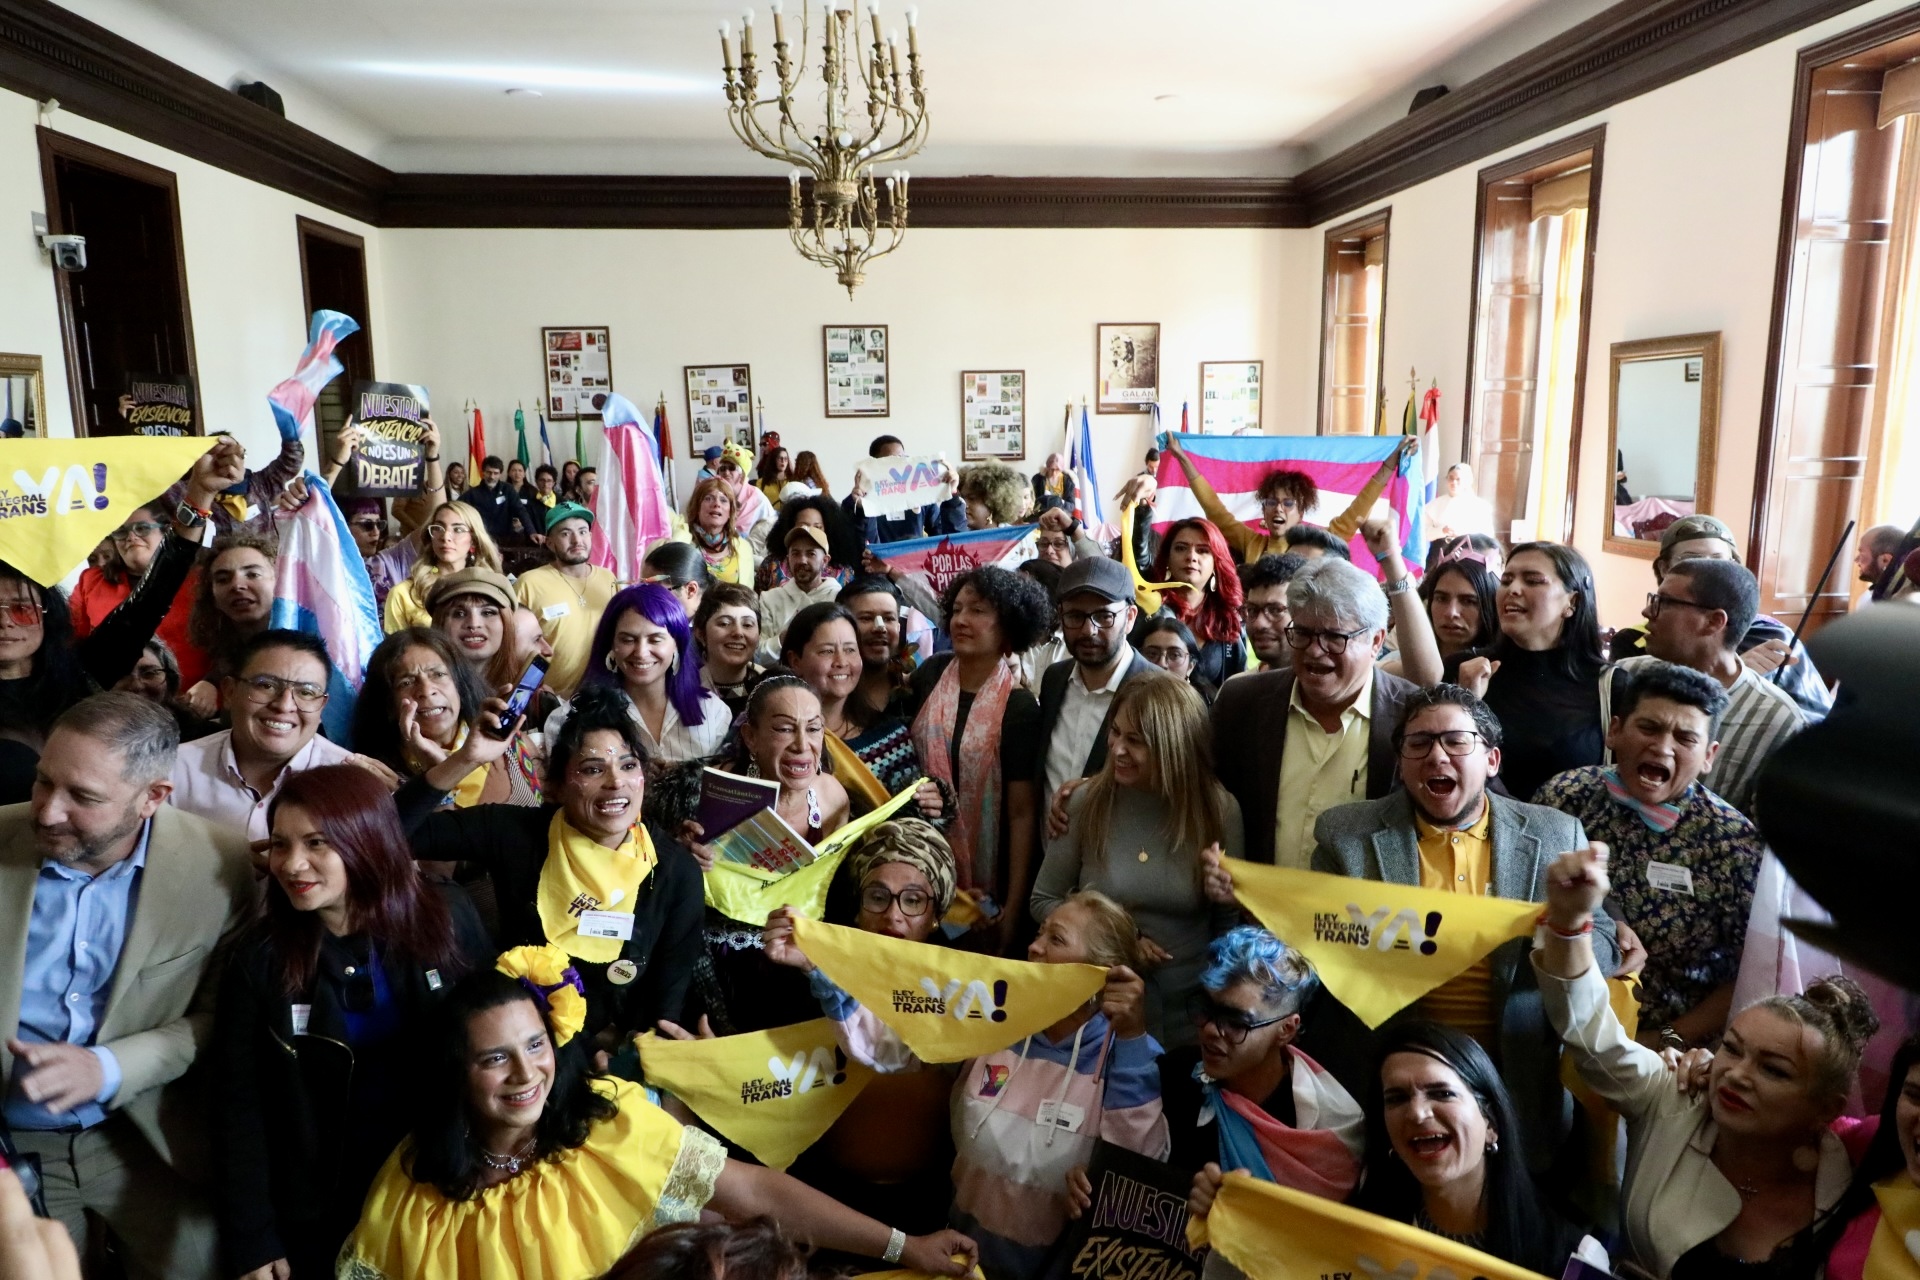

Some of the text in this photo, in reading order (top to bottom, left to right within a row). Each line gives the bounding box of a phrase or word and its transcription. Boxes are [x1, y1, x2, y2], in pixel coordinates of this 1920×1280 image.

[132, 381, 188, 408] NUESTRA
[129, 404, 191, 426] EXISTENCIA
[361, 392, 421, 422] NUESTRA
[141, 424, 182, 436] NO ES UN
[368, 444, 411, 460] NO ES UN
[358, 458, 419, 489] DEBATE
[0, 493, 46, 506] TEGRAL
[0, 502, 47, 519] RANS
[931, 554, 973, 573] POR LAS
[1314, 921, 1370, 935] INTEGRAL
[1345, 903, 1442, 956] YA!
[1314, 929, 1370, 946] TRANS
[892, 996, 946, 1004] INTEGRAL
[892, 1002, 946, 1014] TRANS
[920, 977, 1008, 1023] YA!
[741, 1078, 792, 1095] INTEGRAL
[741, 1086, 792, 1104] TRANS
